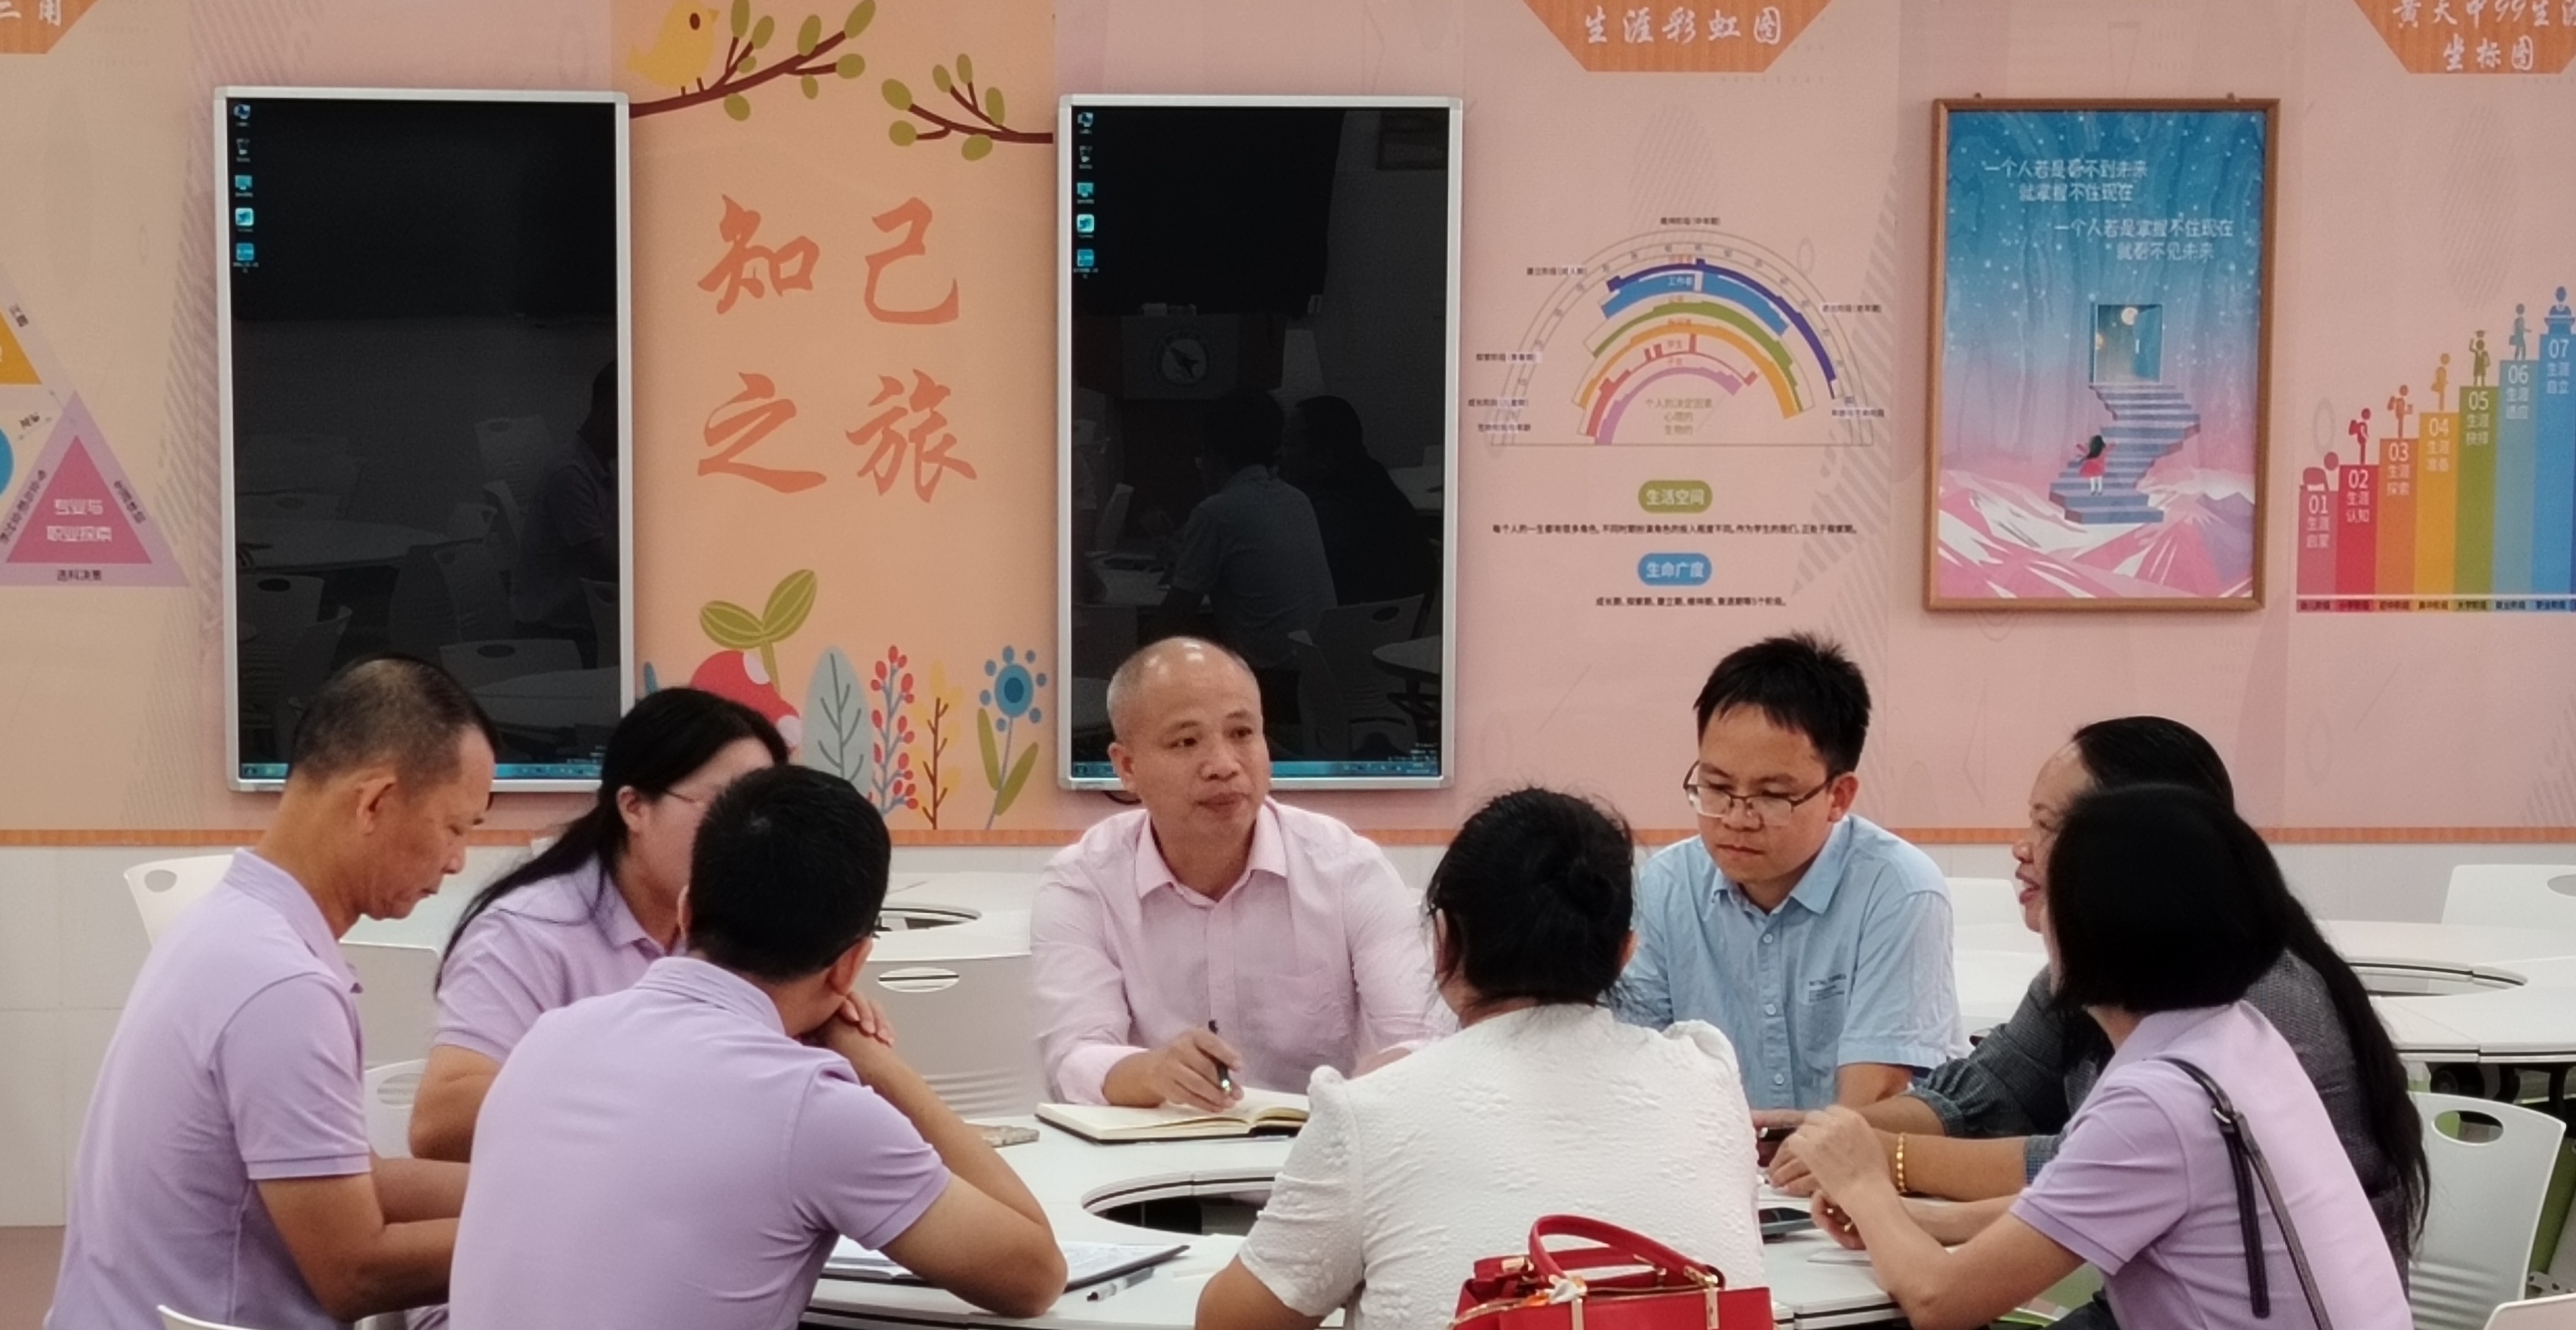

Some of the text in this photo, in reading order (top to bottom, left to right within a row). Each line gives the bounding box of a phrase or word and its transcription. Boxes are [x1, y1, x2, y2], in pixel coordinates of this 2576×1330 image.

[1584, 5, 1781, 45] 生涯彩虹图
[2442, 33, 2534, 71] 坐标图
[1984, 157, 2148, 180] 一个人若是看不到未来
[2018, 182, 2135, 203] 就掌握不住现在
[2054, 218, 2234, 239] 一个人若是掌握不住现在
[696, 193, 960, 325] 知己
[2116, 241, 2215, 263] 就看不见未来
[2549, 339, 2569, 358] 07
[2508, 364, 2528, 384] 06
[2547, 362, 2569, 378] 生涯
[2506, 386, 2529, 402] 生涯
[2547, 380, 2569, 395] 自立
[2468, 391, 2488, 410] 05
[2429, 417, 2448, 437] 04
[2467, 413, 2489, 429] 生涯
[696, 367, 978, 504] 之旅
[2389, 443, 2409, 462] 03
[2427, 439, 2449, 456] 生涯
[2348, 469, 2369, 490] 02
[2387, 464, 2410, 480] 生涯
[1645, 488, 1705, 506] 生活空间
[2308, 495, 2329, 514] 01
[2347, 491, 2370, 507] 生涯
[2307, 516, 2330, 532] 生涯
[2346, 508, 2370, 524] 认知
[1645, 561, 1705, 579] 生命广度
